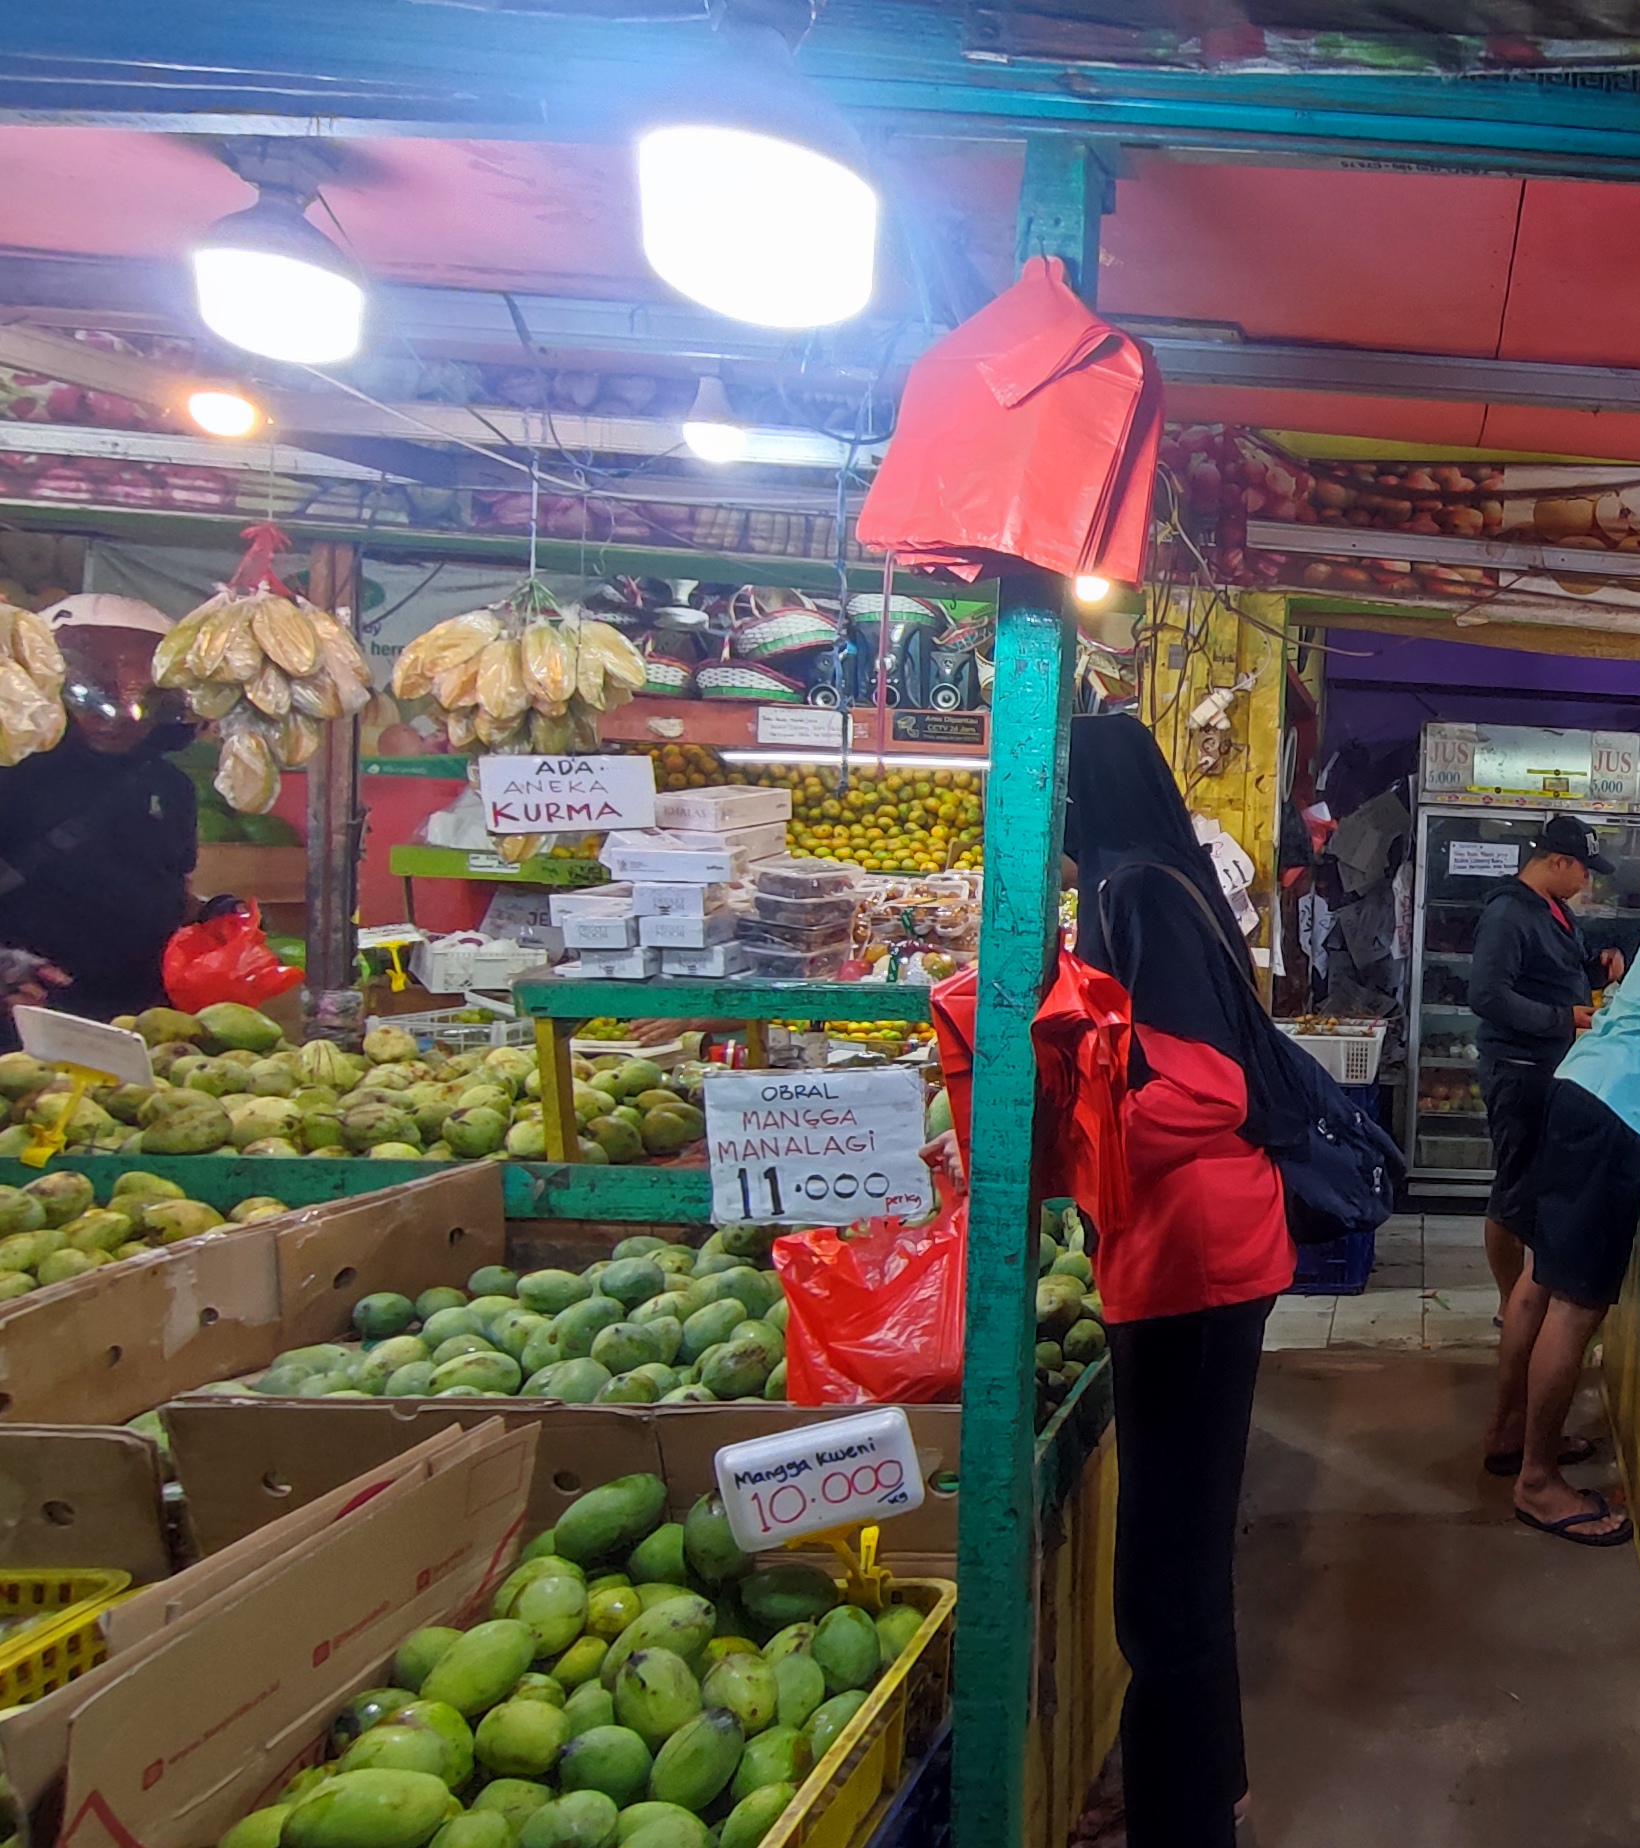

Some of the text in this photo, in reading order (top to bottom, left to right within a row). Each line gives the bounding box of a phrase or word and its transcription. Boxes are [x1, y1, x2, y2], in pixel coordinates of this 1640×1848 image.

[1429, 740, 1469, 765] JUS
[1593, 749, 1631, 774] JUS
[503, 780, 609, 795] ANEKA
[491, 801, 623, 828] KURMA
[761, 1083, 840, 1102] OBRAL
[742, 1108, 858, 1133] MANGGA
[737, 1166, 891, 1221] 11.000
[735, 1456, 812, 1490] Mangga
[751, 1459, 904, 1532] 10.000
